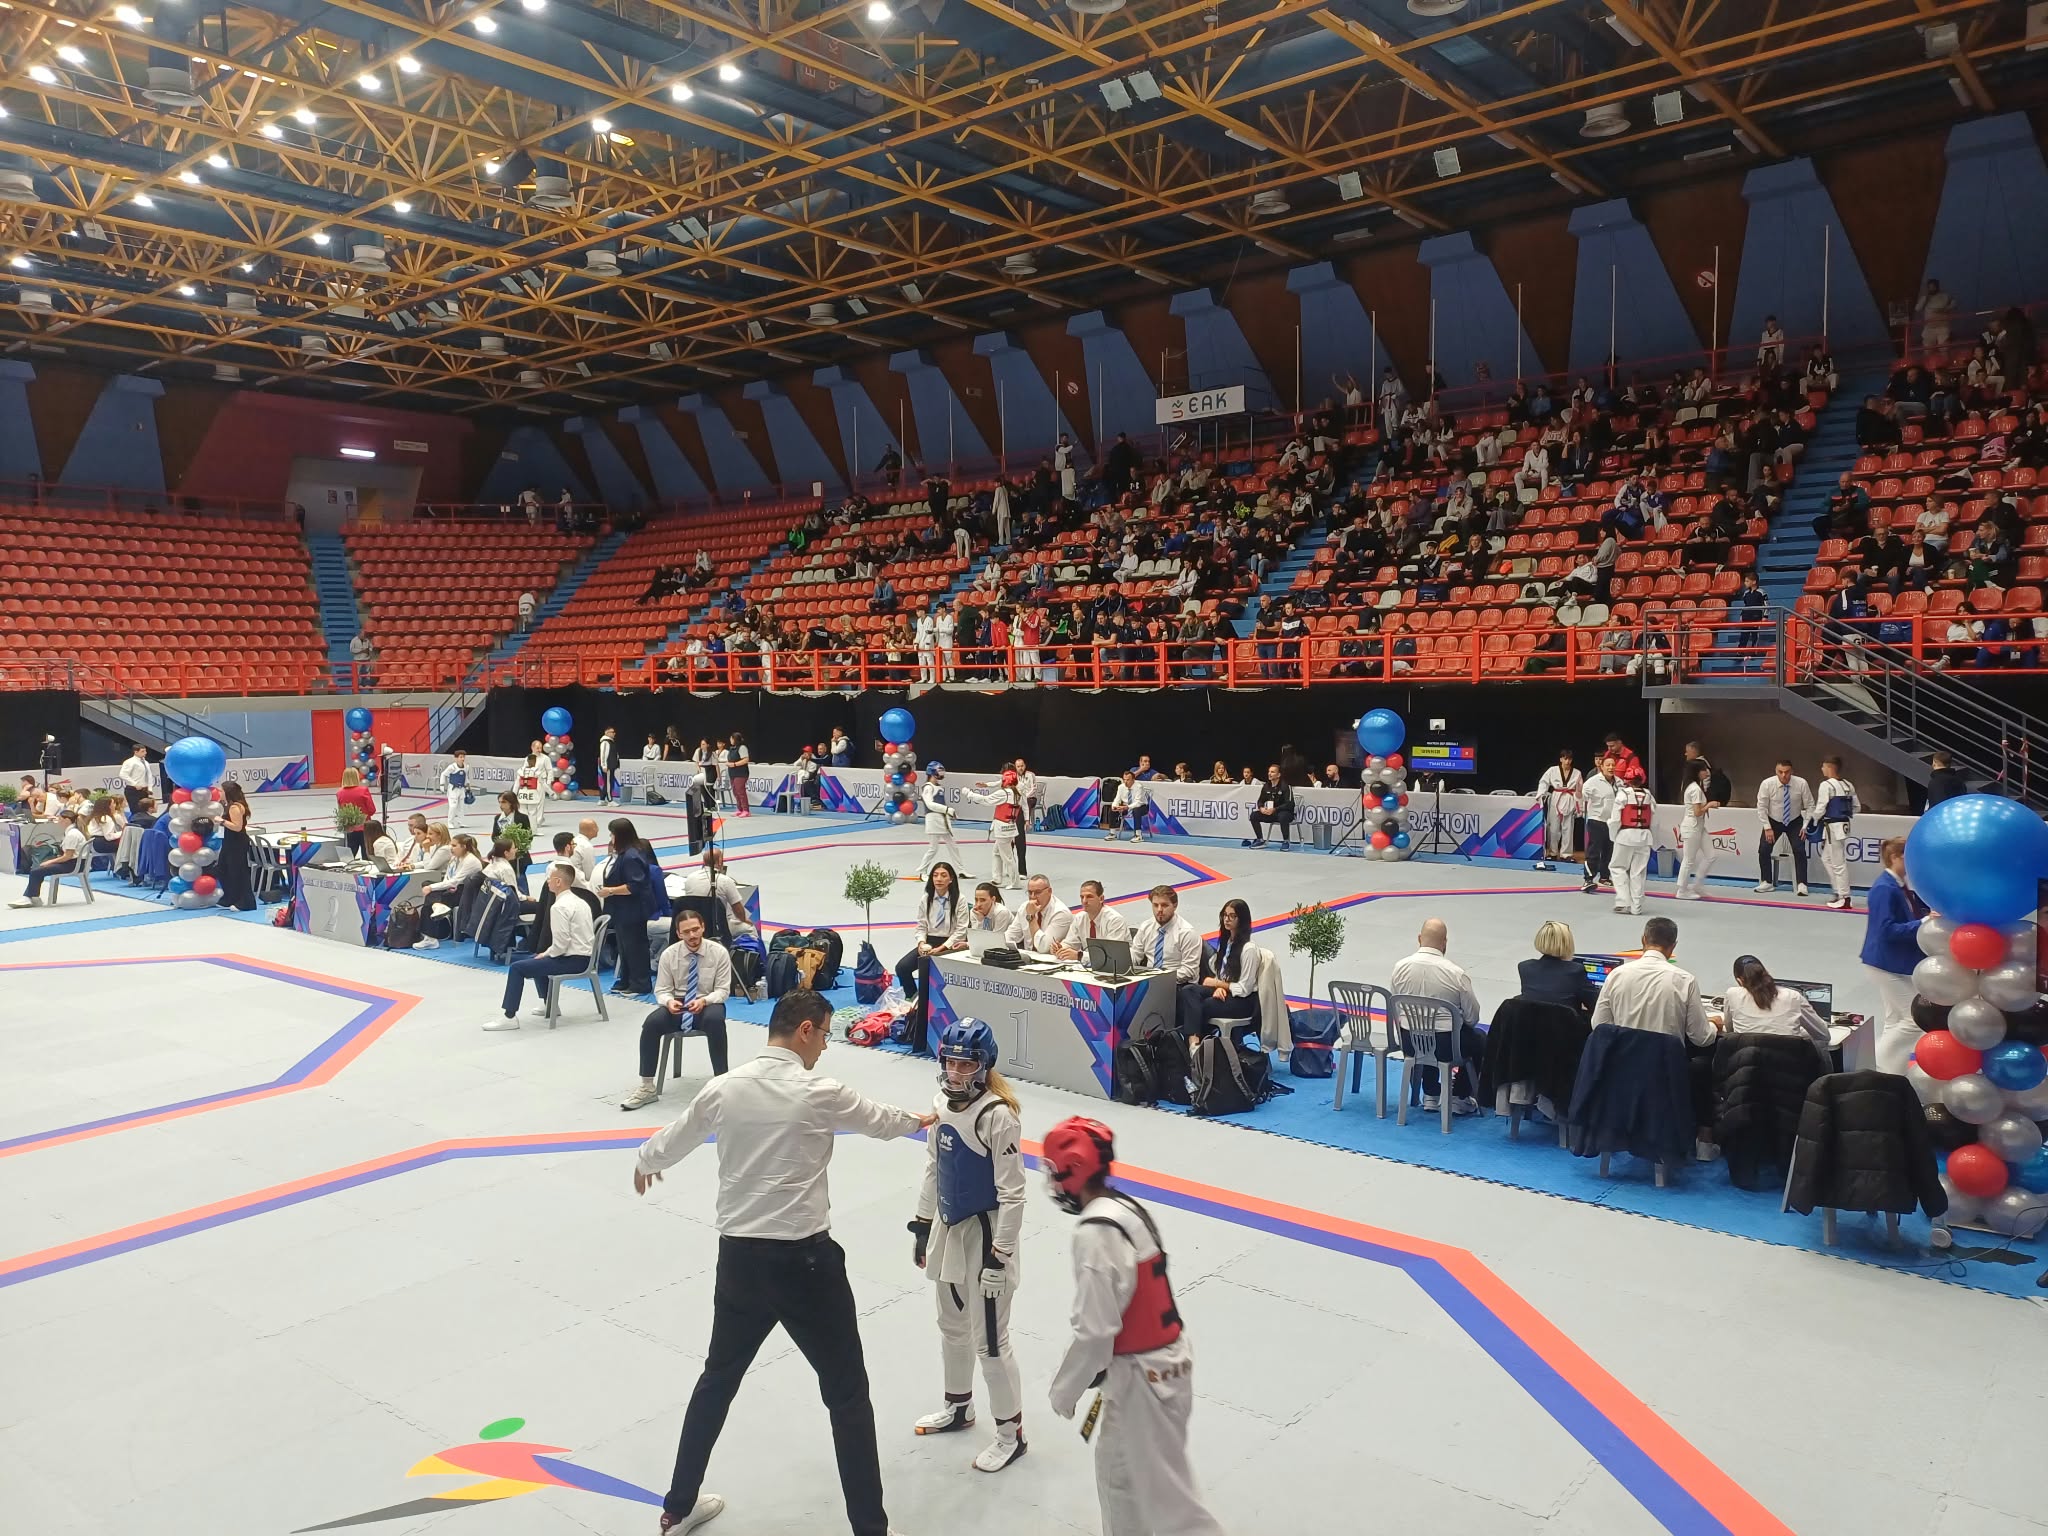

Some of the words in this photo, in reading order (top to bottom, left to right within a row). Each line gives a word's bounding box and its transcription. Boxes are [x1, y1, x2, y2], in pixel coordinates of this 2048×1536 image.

[226, 770, 239, 782] IS
[243, 768, 269, 781] YOU
[487, 767, 515, 781] DREAM
[853, 783, 880, 798] YOUR
[949, 787, 961, 803] IS
[1168, 799, 1239, 820] HELLENIC
[943, 972, 981, 991] HELLENIC
[982, 979, 1038, 1001] TAEKWONDO
[1041, 991, 1098, 1013] FEDERATION
[1008, 1009, 1034, 1070] 1
